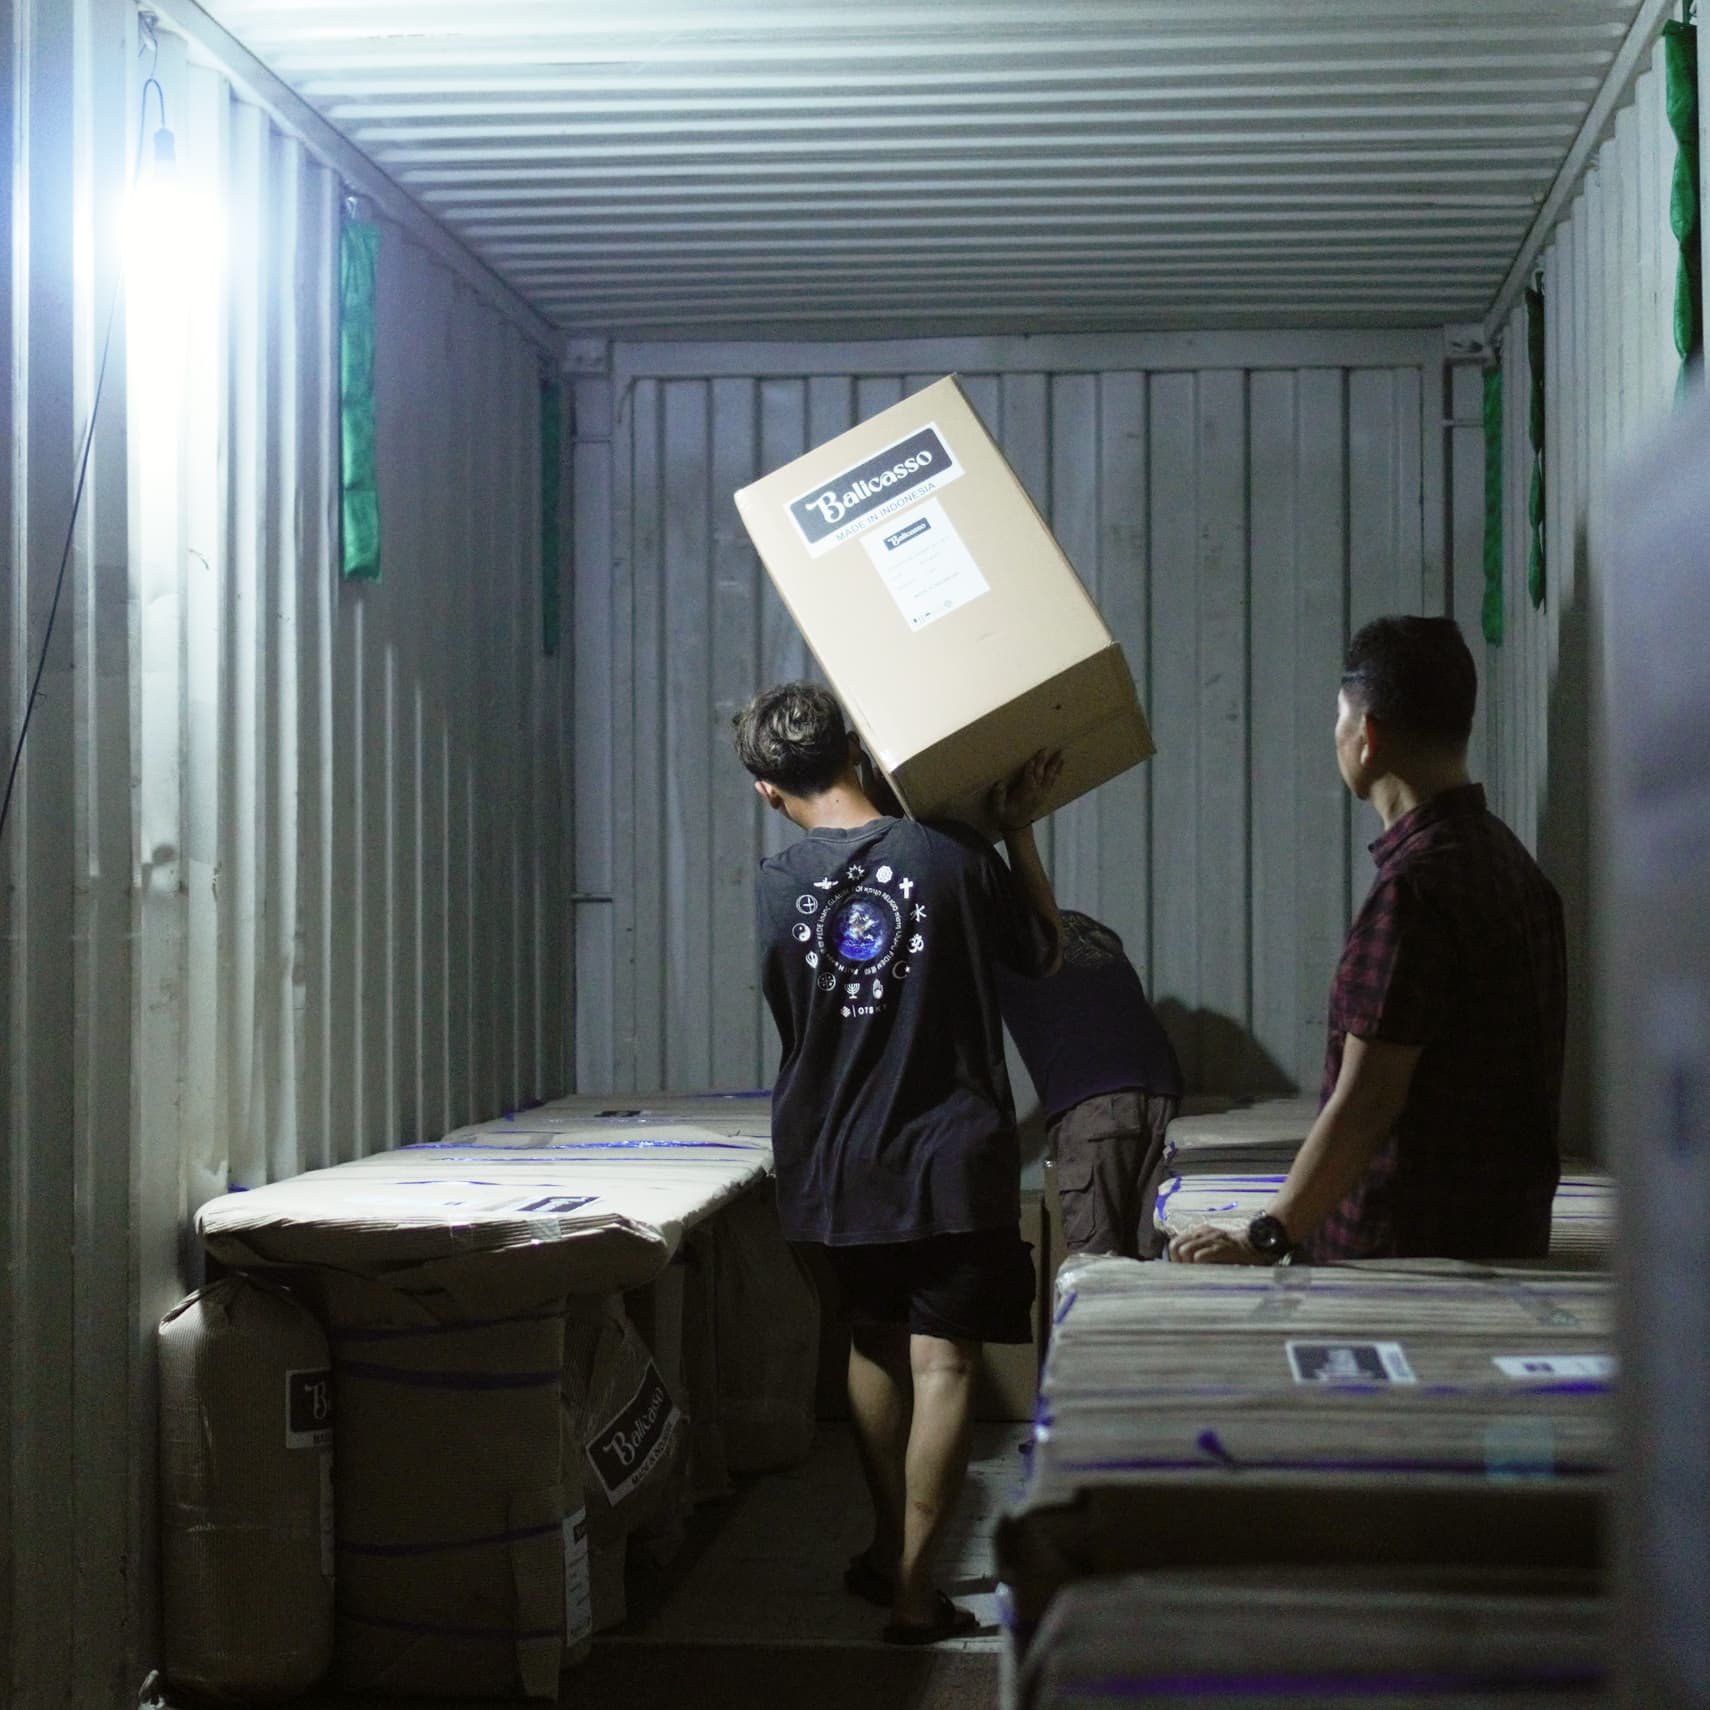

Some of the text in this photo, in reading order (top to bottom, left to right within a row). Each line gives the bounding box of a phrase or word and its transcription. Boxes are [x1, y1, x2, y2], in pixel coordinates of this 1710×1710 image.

[805, 450, 933, 524] Balicasso
[836, 482, 936, 541] MADE IN INDONESIA
